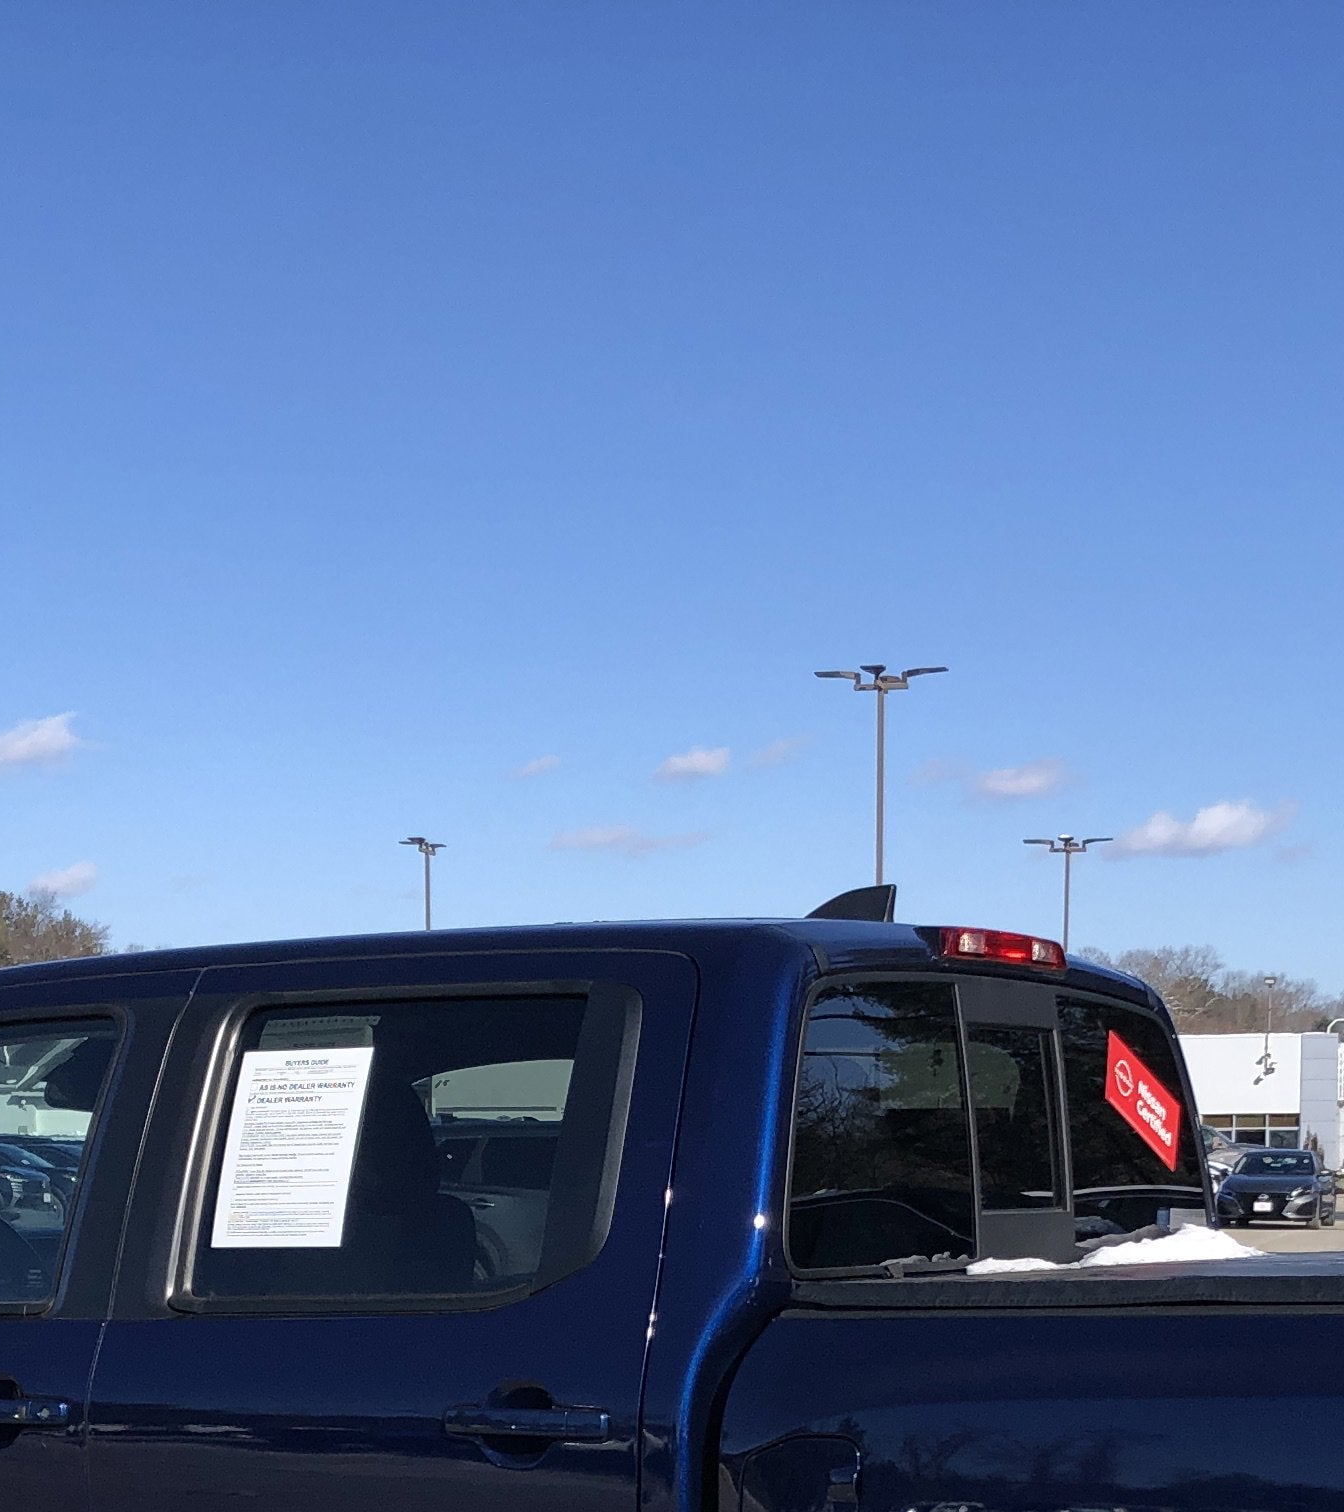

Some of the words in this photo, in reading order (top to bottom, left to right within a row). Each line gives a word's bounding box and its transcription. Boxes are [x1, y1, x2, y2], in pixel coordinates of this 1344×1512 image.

[285, 1059, 309, 1067] BUYERS
[289, 1082, 316, 1090] DEALER
[317, 1081, 355, 1089] WARRANTY
[285, 1095, 323, 1103] WARRANTY
